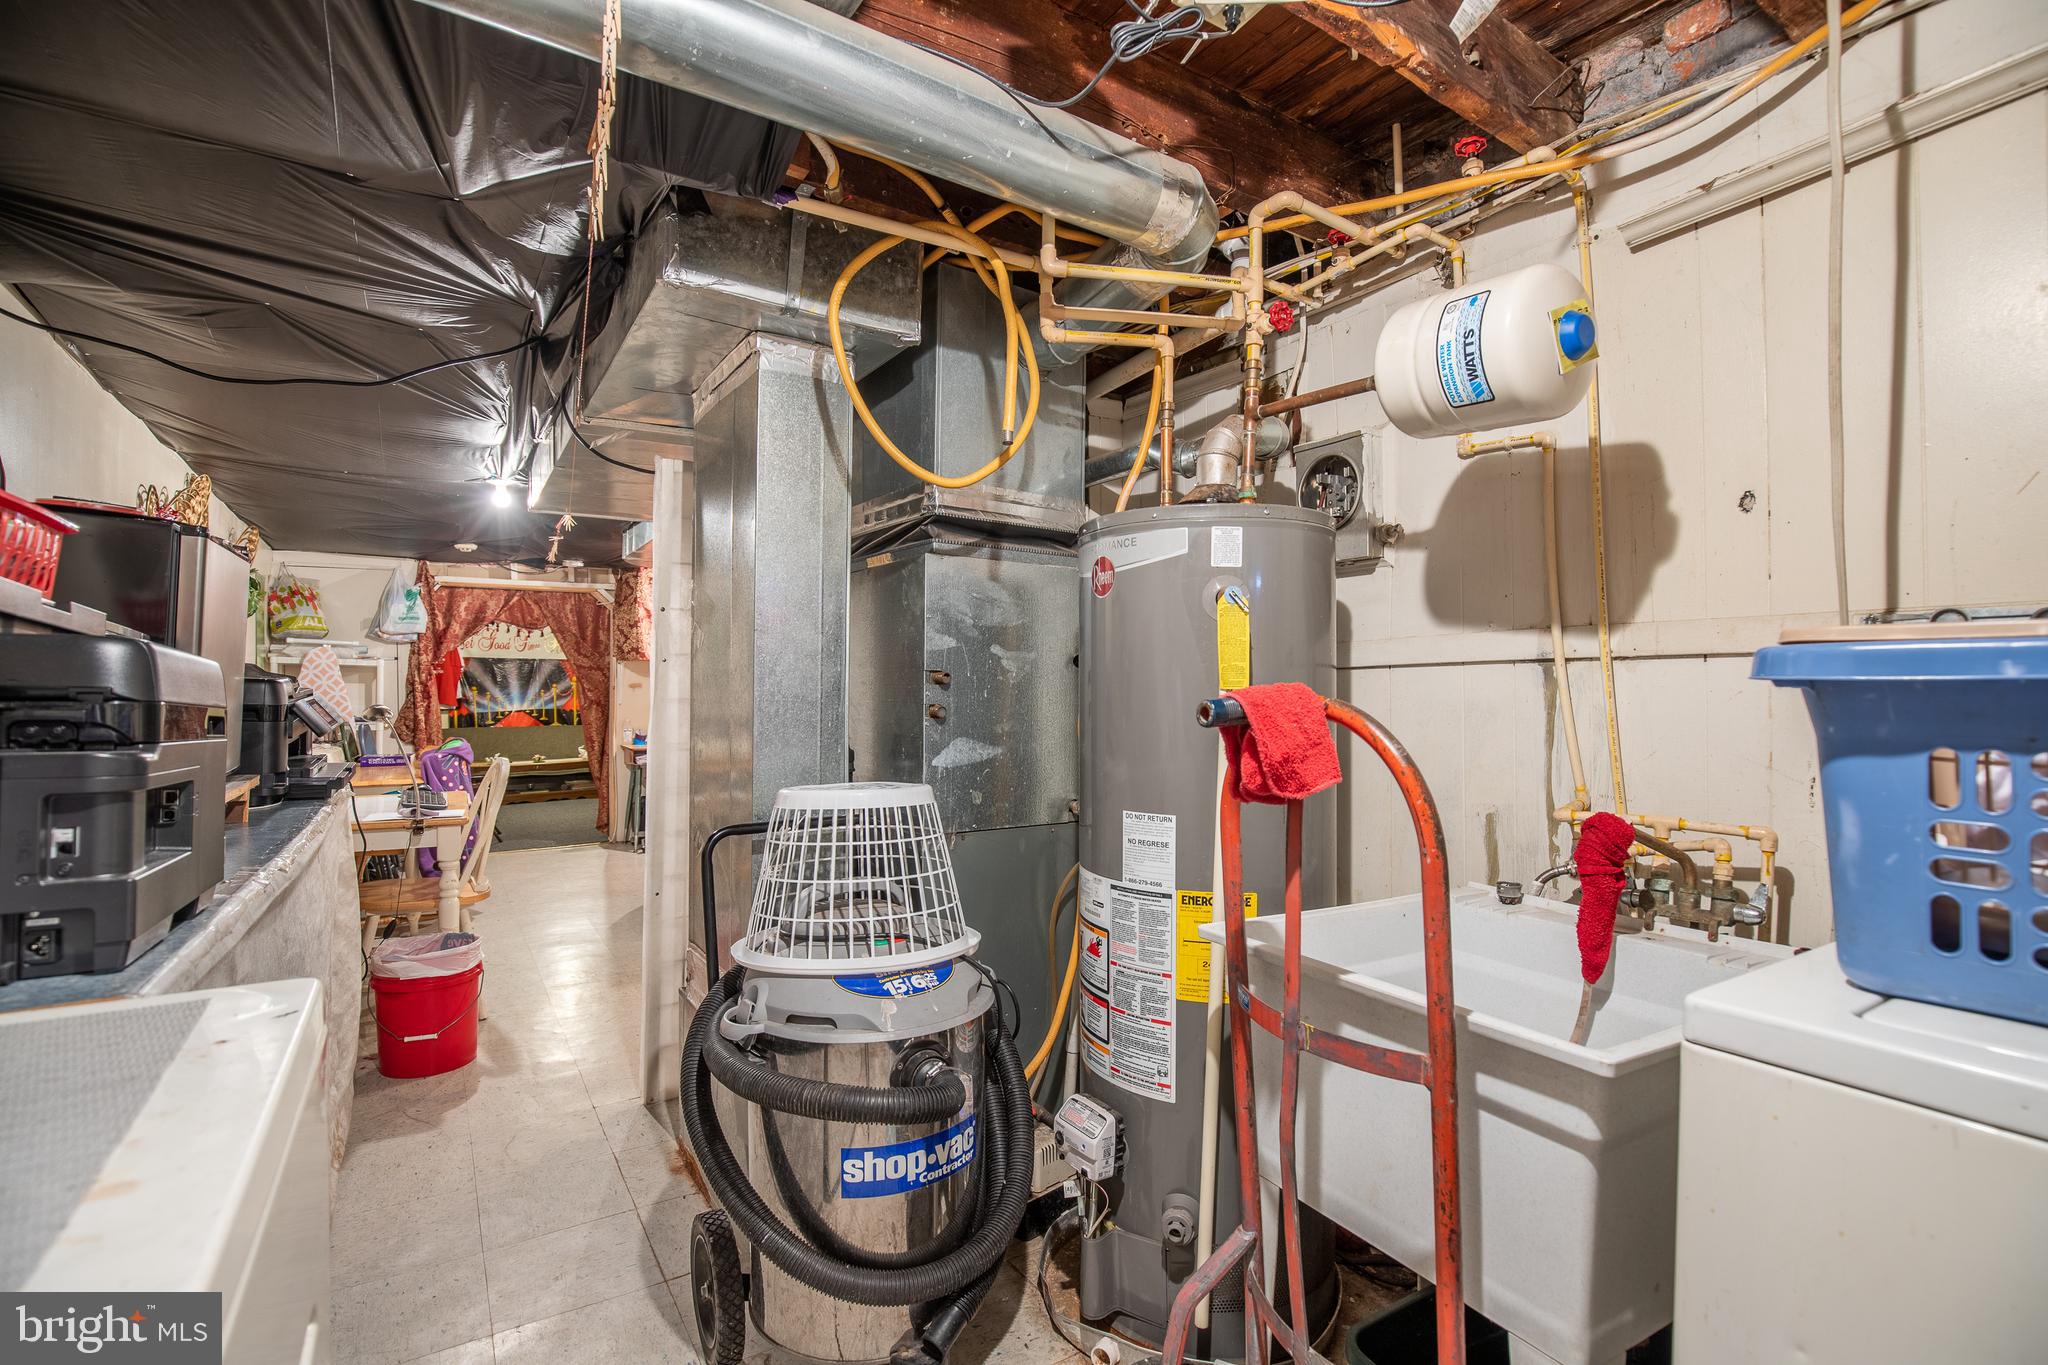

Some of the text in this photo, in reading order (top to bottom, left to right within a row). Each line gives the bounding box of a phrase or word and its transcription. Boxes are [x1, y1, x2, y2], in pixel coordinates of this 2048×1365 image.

[1463, 328, 1479, 382] WATTS
[1442, 371, 1458, 404] POTABLE
[1447, 363, 1464, 403] EXPANSION
[1093, 556, 1114, 591] Rheem
[1147, 815, 1173, 823] RETURN
[1138, 839, 1170, 848] REGRESE
[919, 1149, 974, 1183] Contractor
